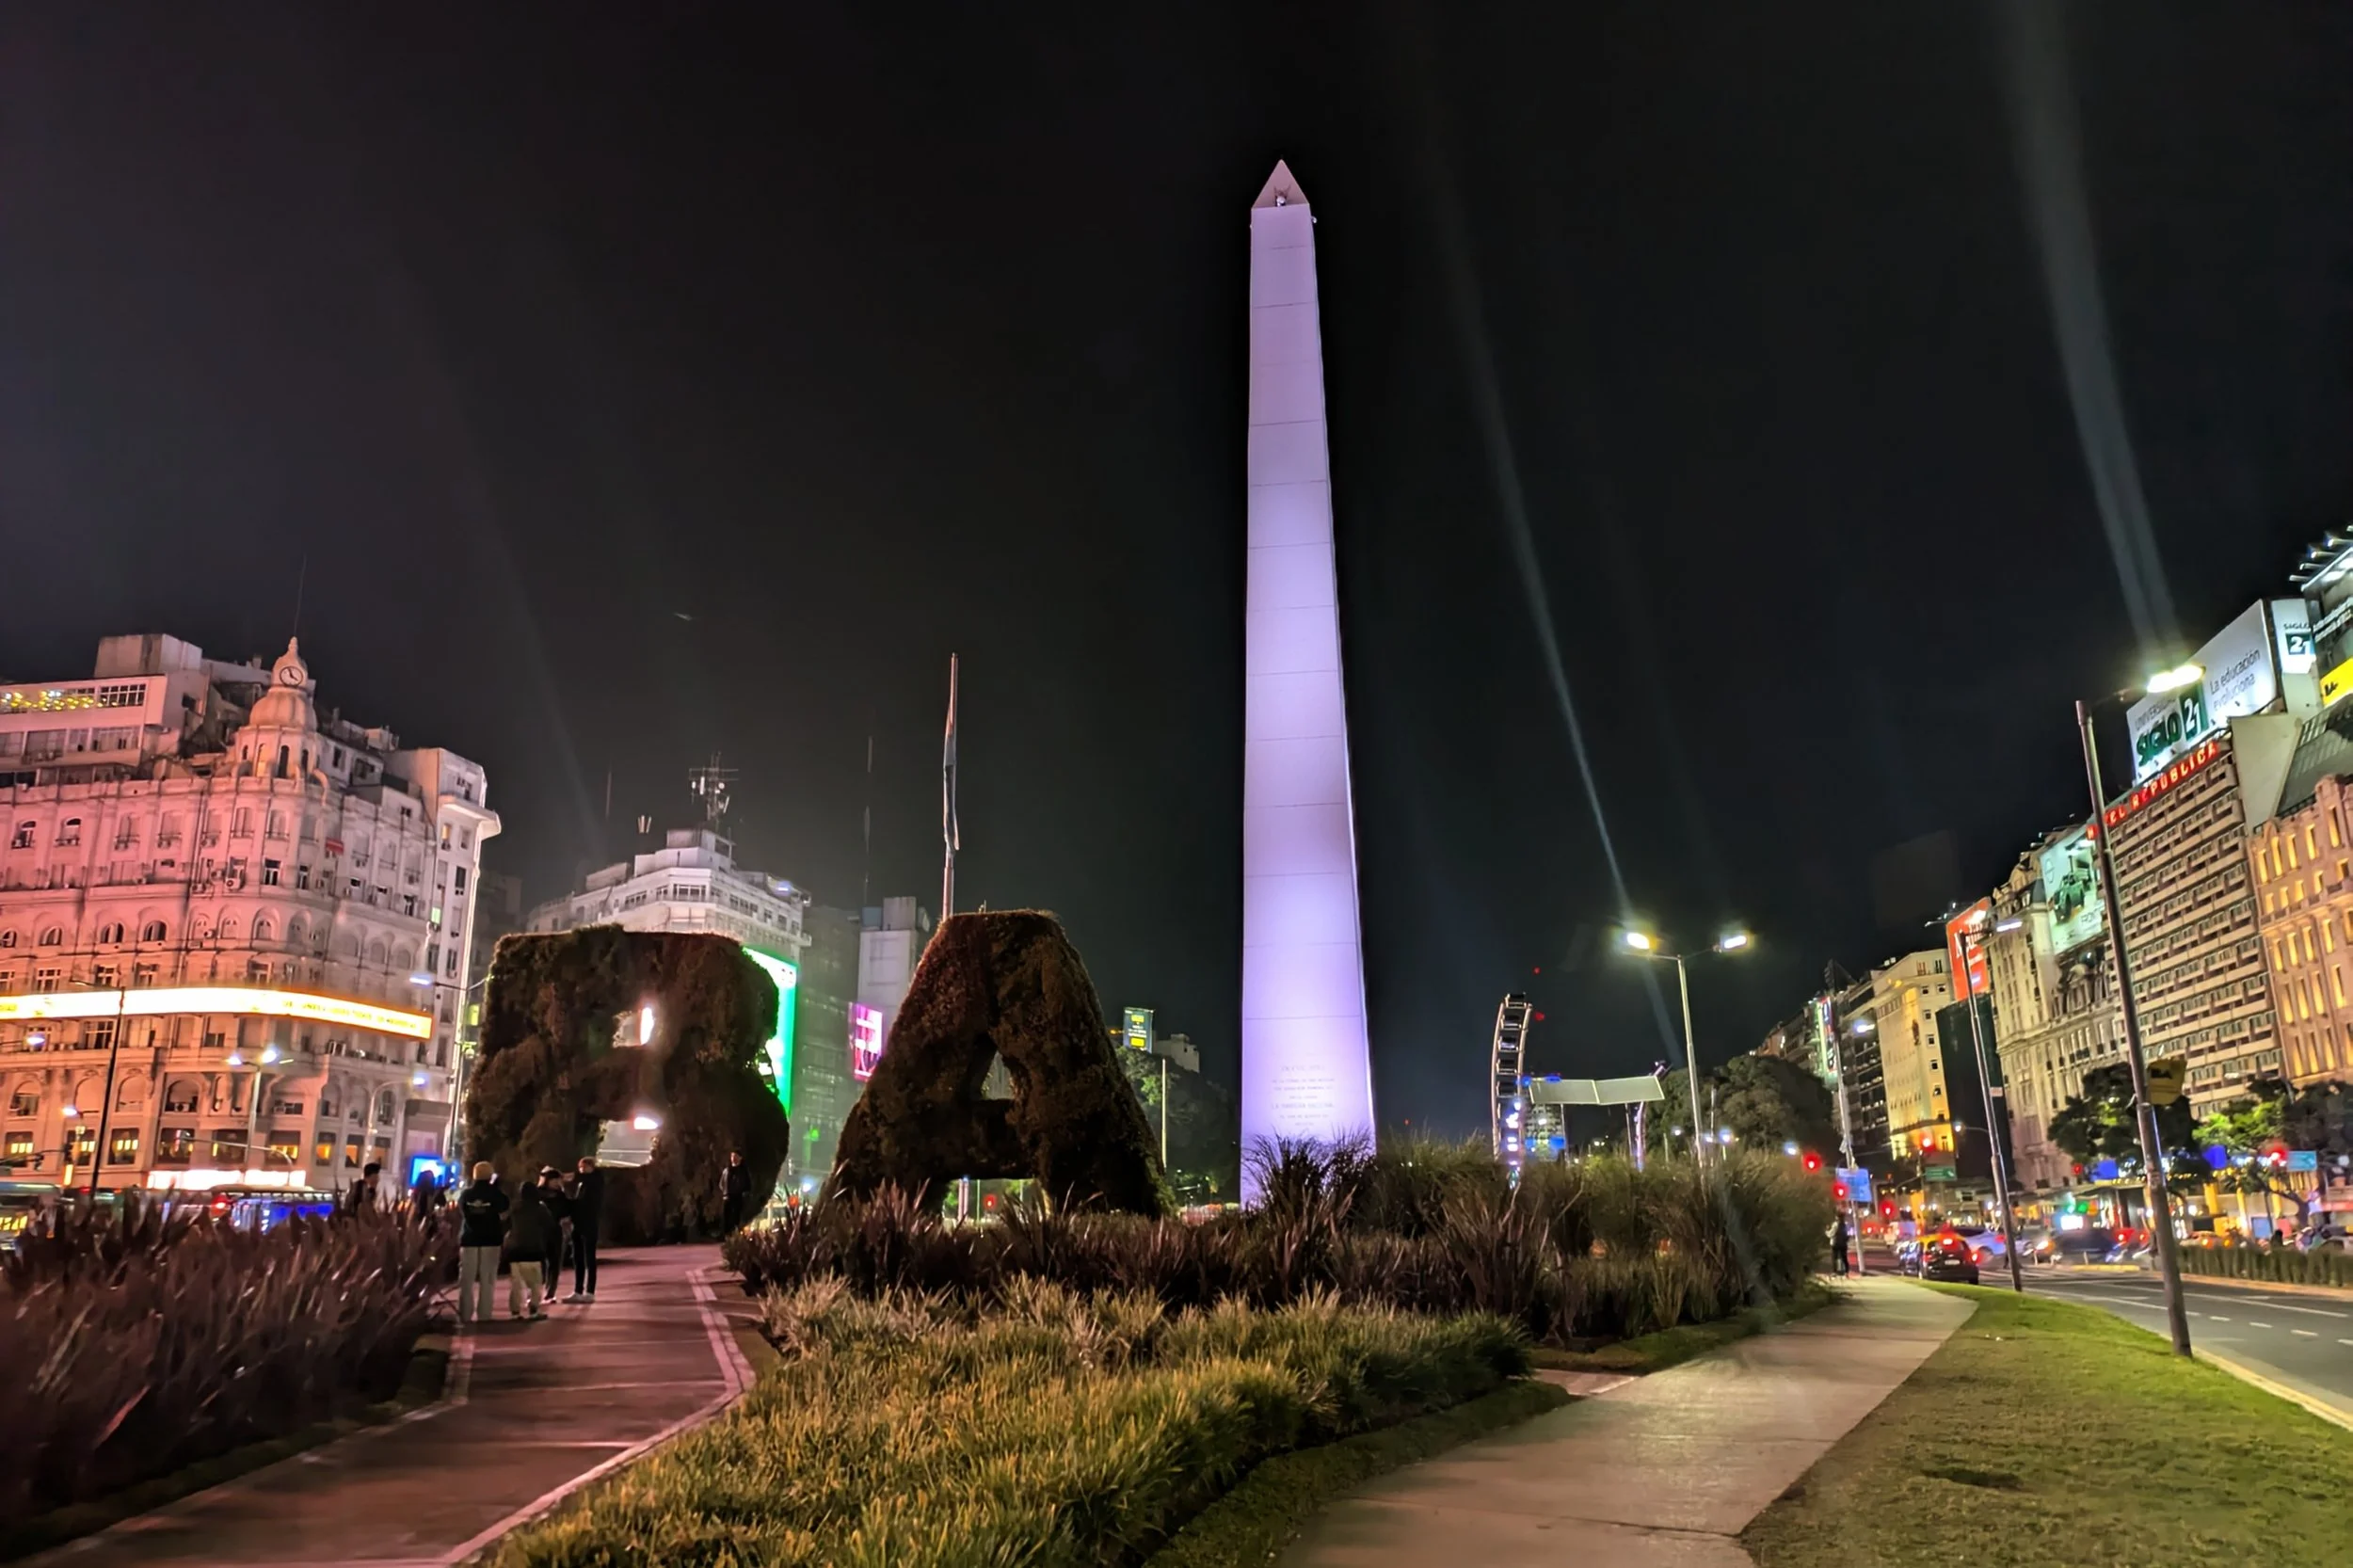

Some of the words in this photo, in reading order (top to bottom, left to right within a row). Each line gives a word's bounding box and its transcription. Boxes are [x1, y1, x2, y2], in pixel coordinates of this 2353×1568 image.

[2209, 680, 2219, 695] La
[2184, 697, 2201, 735] 21
[2086, 806, 2127, 840] HEL
